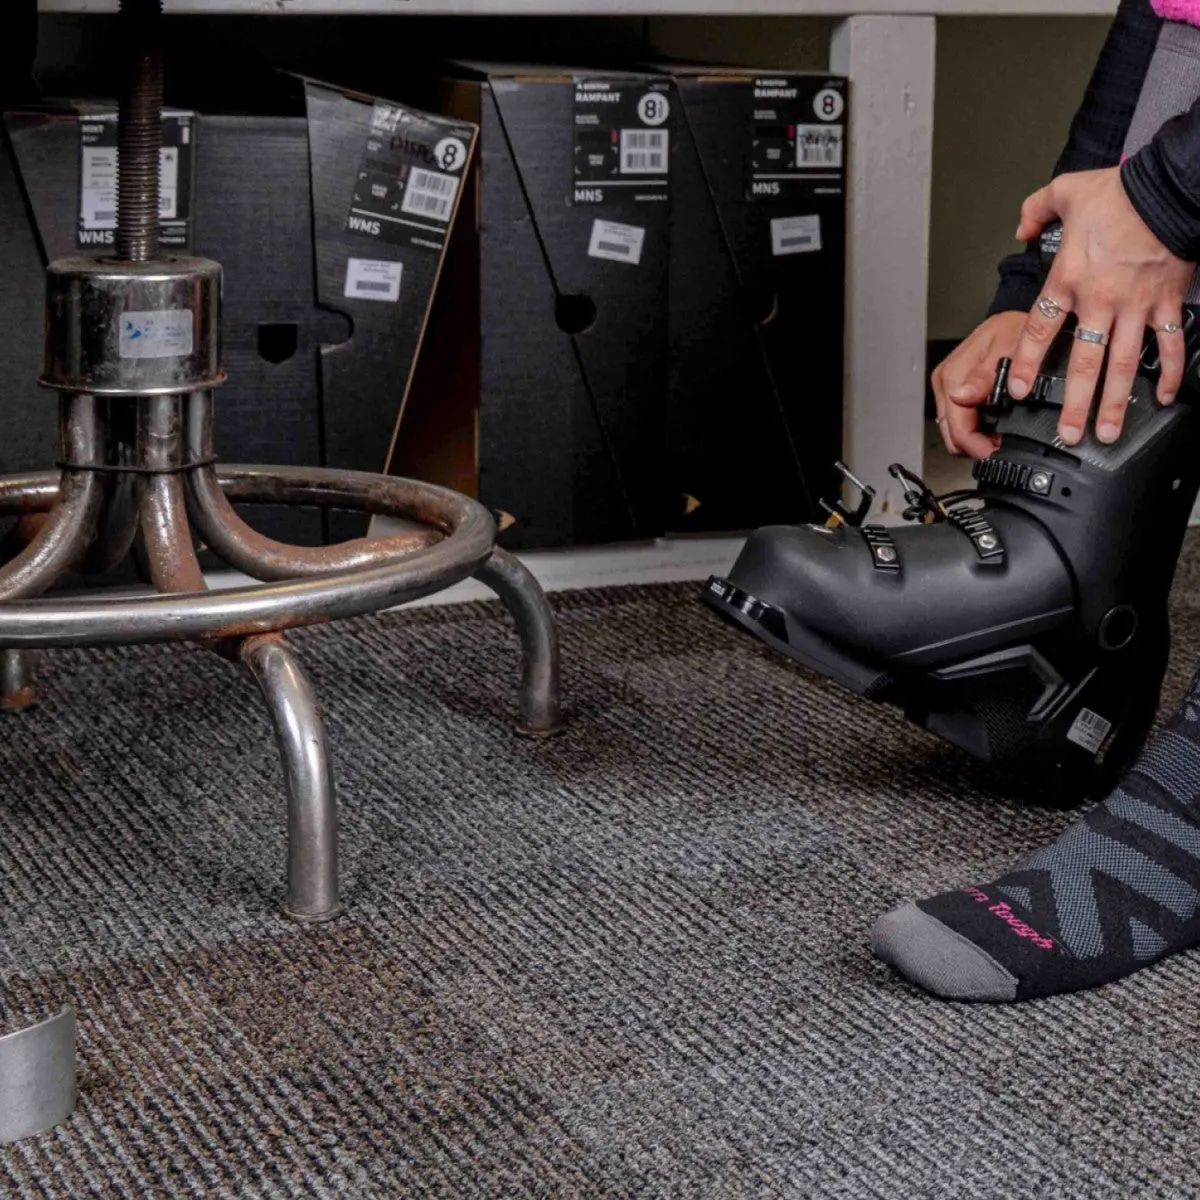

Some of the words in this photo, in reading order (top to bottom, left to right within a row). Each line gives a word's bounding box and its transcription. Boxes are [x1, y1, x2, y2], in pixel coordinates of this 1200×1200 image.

[575, 92, 621, 103] RAMPANT
[754, 88, 798, 98] RAMPANT
[752, 182, 780, 195] MNS
[574, 189, 603, 202] MNS
[349, 216, 381, 235] WMS
[79, 230, 115, 244] WMS
